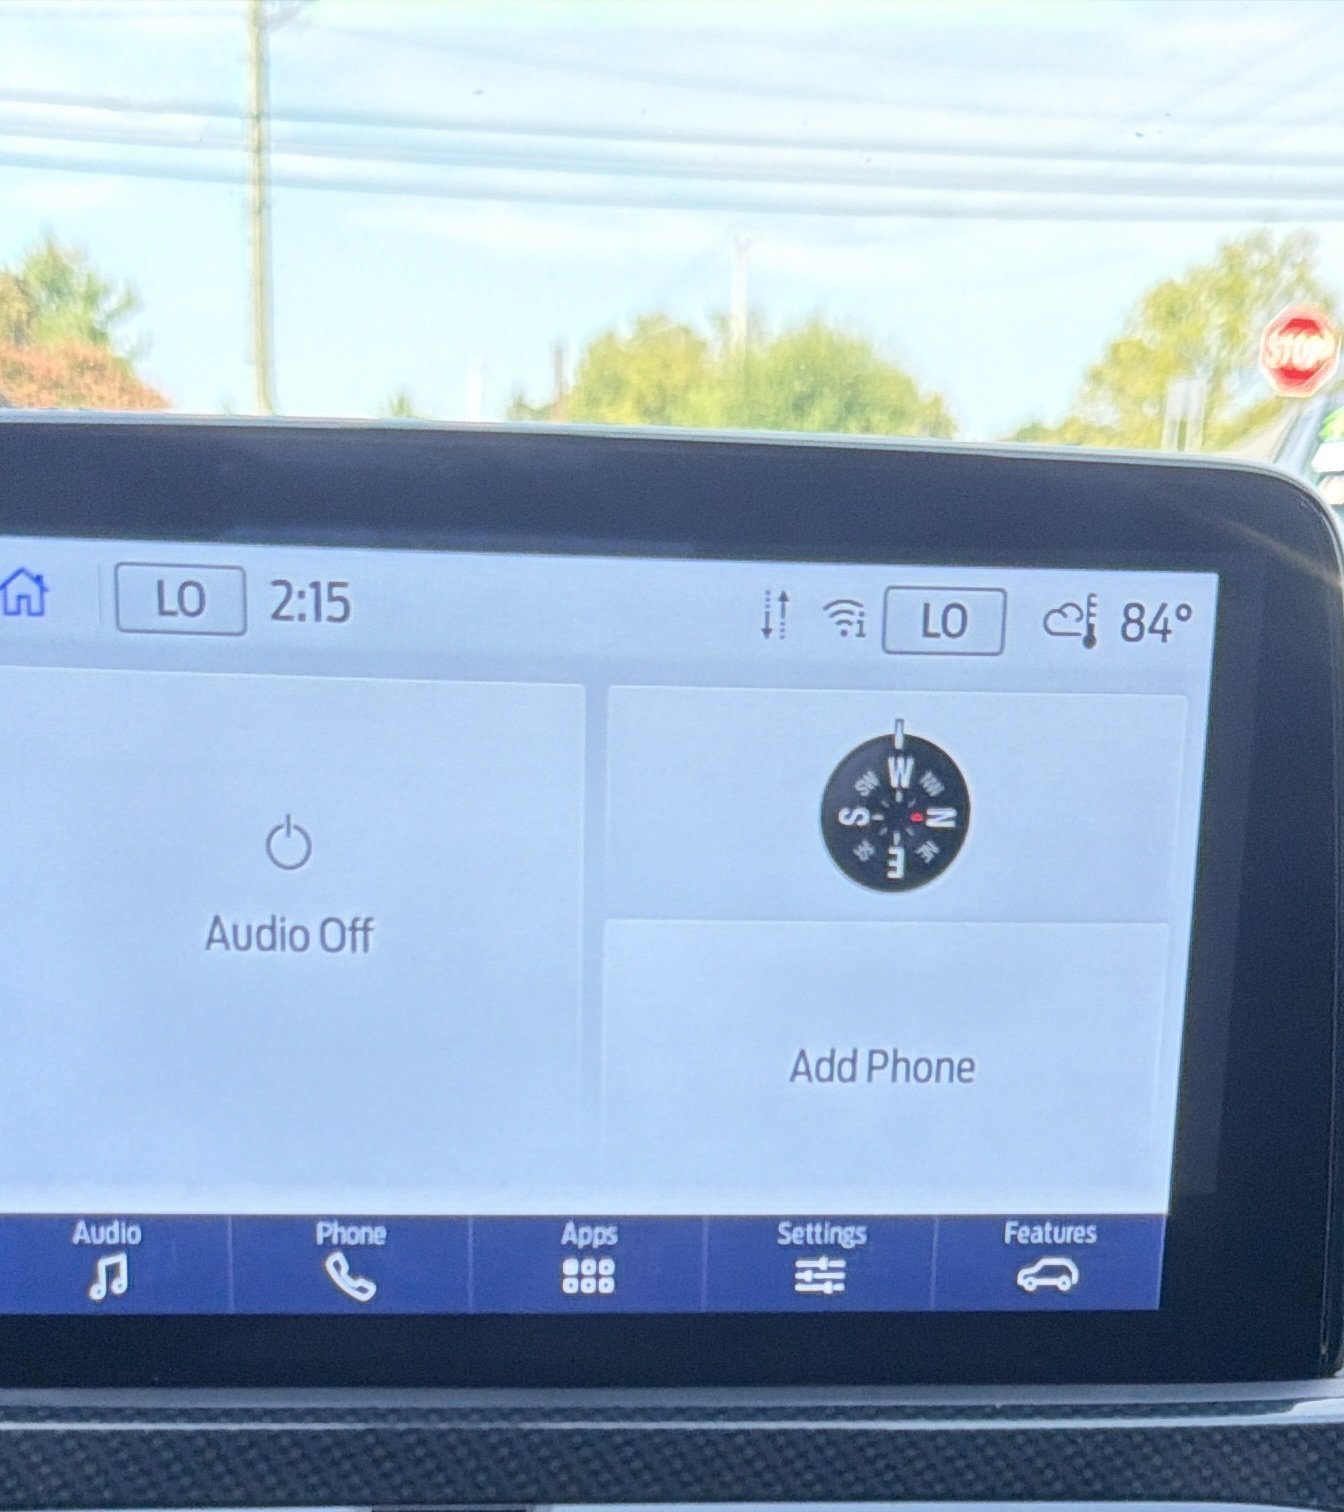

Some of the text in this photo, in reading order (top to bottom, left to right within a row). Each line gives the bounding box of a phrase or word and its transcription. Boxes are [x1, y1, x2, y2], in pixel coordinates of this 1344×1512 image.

[1265, 328, 1336, 369] STOP
[157, 579, 206, 618] LO
[270, 579, 351, 623] 2:15
[921, 602, 969, 639] LO
[1120, 602, 1192, 643] 84°
[887, 756, 915, 789] W
[838, 807, 871, 827] S
[925, 807, 957, 828] N
[886, 847, 904, 879] E
[205, 914, 376, 954] Audio Off
[789, 1047, 977, 1084] Add Phone
[72, 1220, 142, 1246] Audio
[316, 1220, 388, 1246] Phone
[561, 1220, 618, 1247] Apps
[777, 1221, 868, 1247] Settings
[1004, 1220, 1097, 1245] Features
